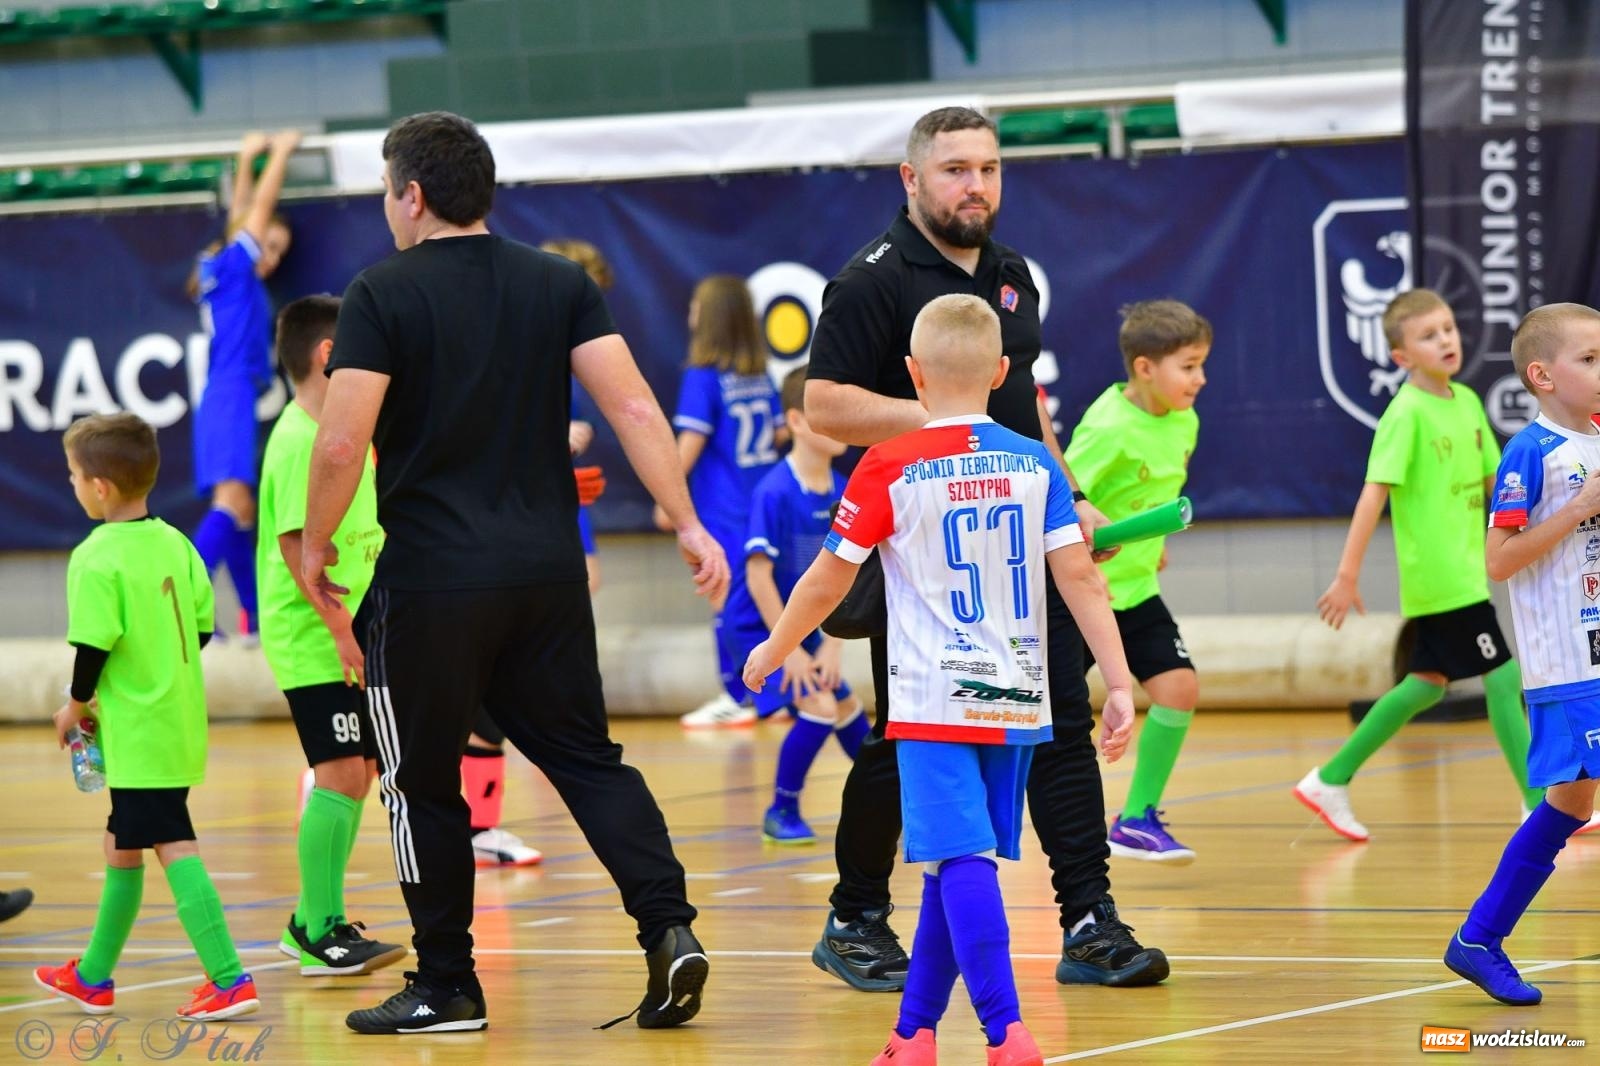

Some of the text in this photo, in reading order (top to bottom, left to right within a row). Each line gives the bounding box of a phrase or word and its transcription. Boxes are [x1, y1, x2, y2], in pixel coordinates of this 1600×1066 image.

[1480, 138, 1520, 331] JUNIOR
[729, 400, 778, 468] 22
[904, 457, 955, 484] SPÓJNIA
[942, 503, 1029, 624] 57
[161, 575, 189, 664] 1
[1476, 632, 1498, 660] 8
[332, 712, 361, 743] 99
